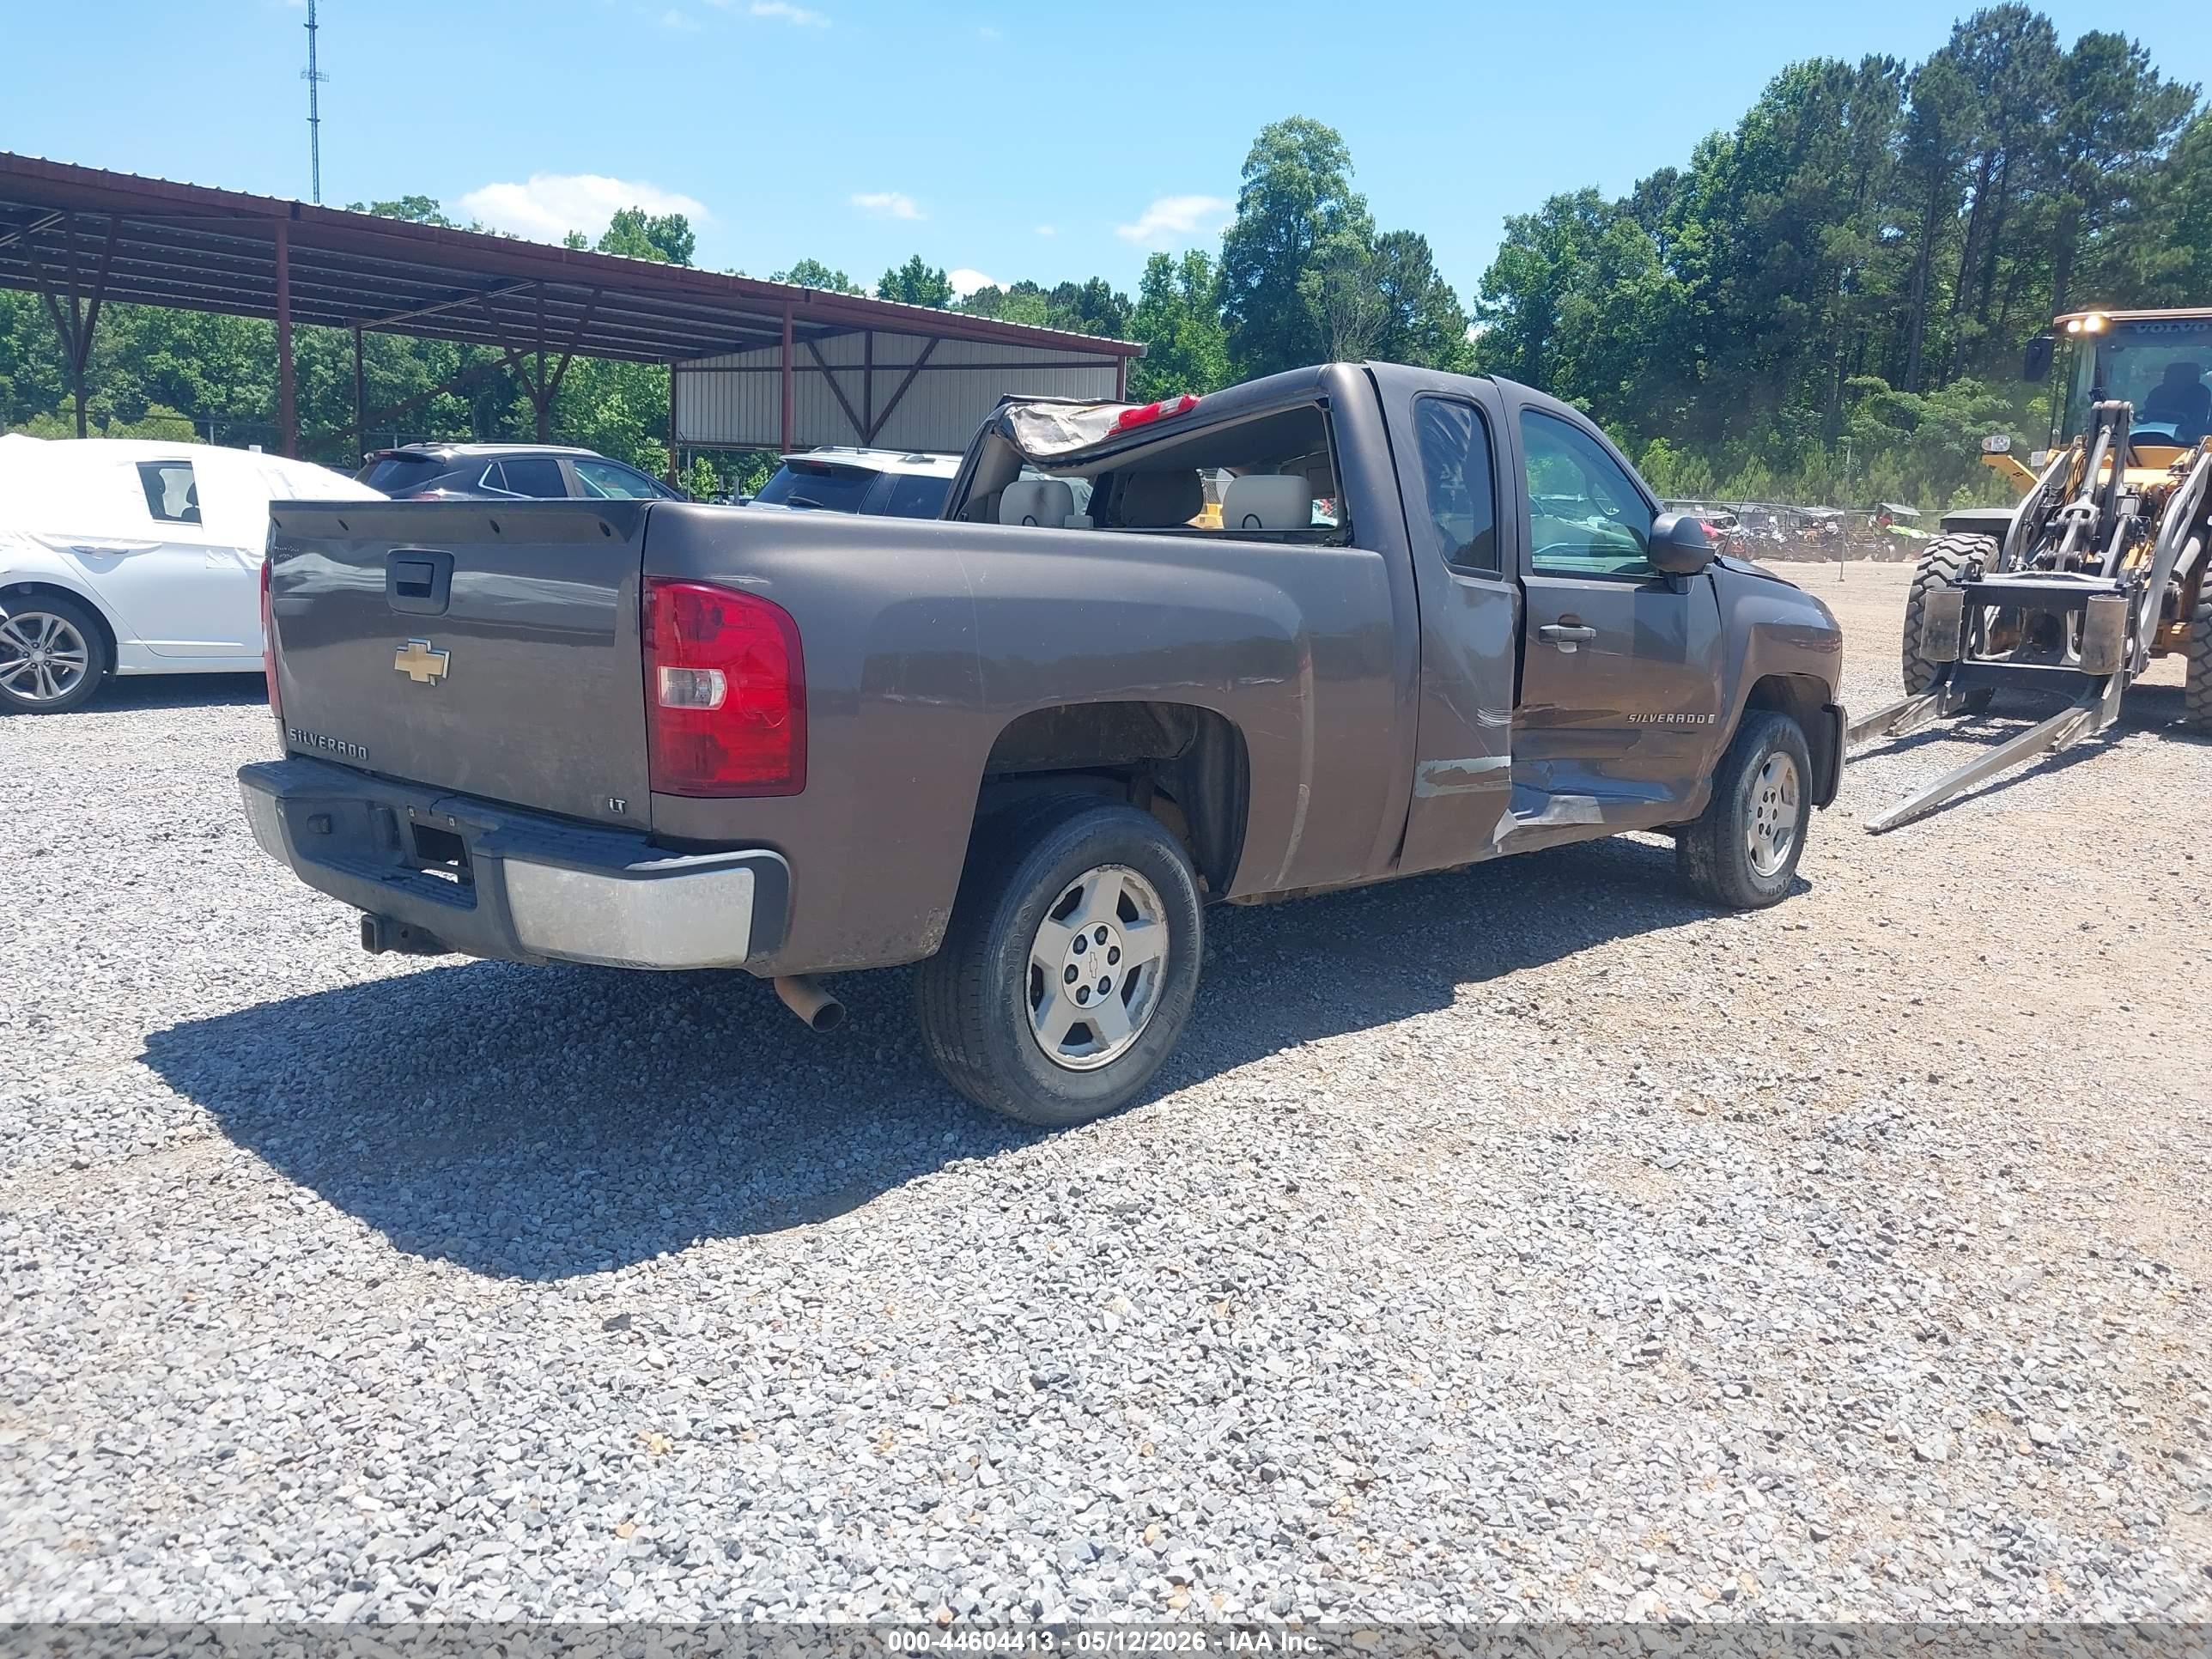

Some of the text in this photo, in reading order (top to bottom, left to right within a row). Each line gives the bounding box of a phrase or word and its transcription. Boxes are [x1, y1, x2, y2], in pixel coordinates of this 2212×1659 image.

[2136, 323, 2209, 333] VOLVO
[1627, 714, 1705, 724] SILVERADO
[289, 728, 368, 761] SILVERADO
[609, 798, 626, 813] LT
